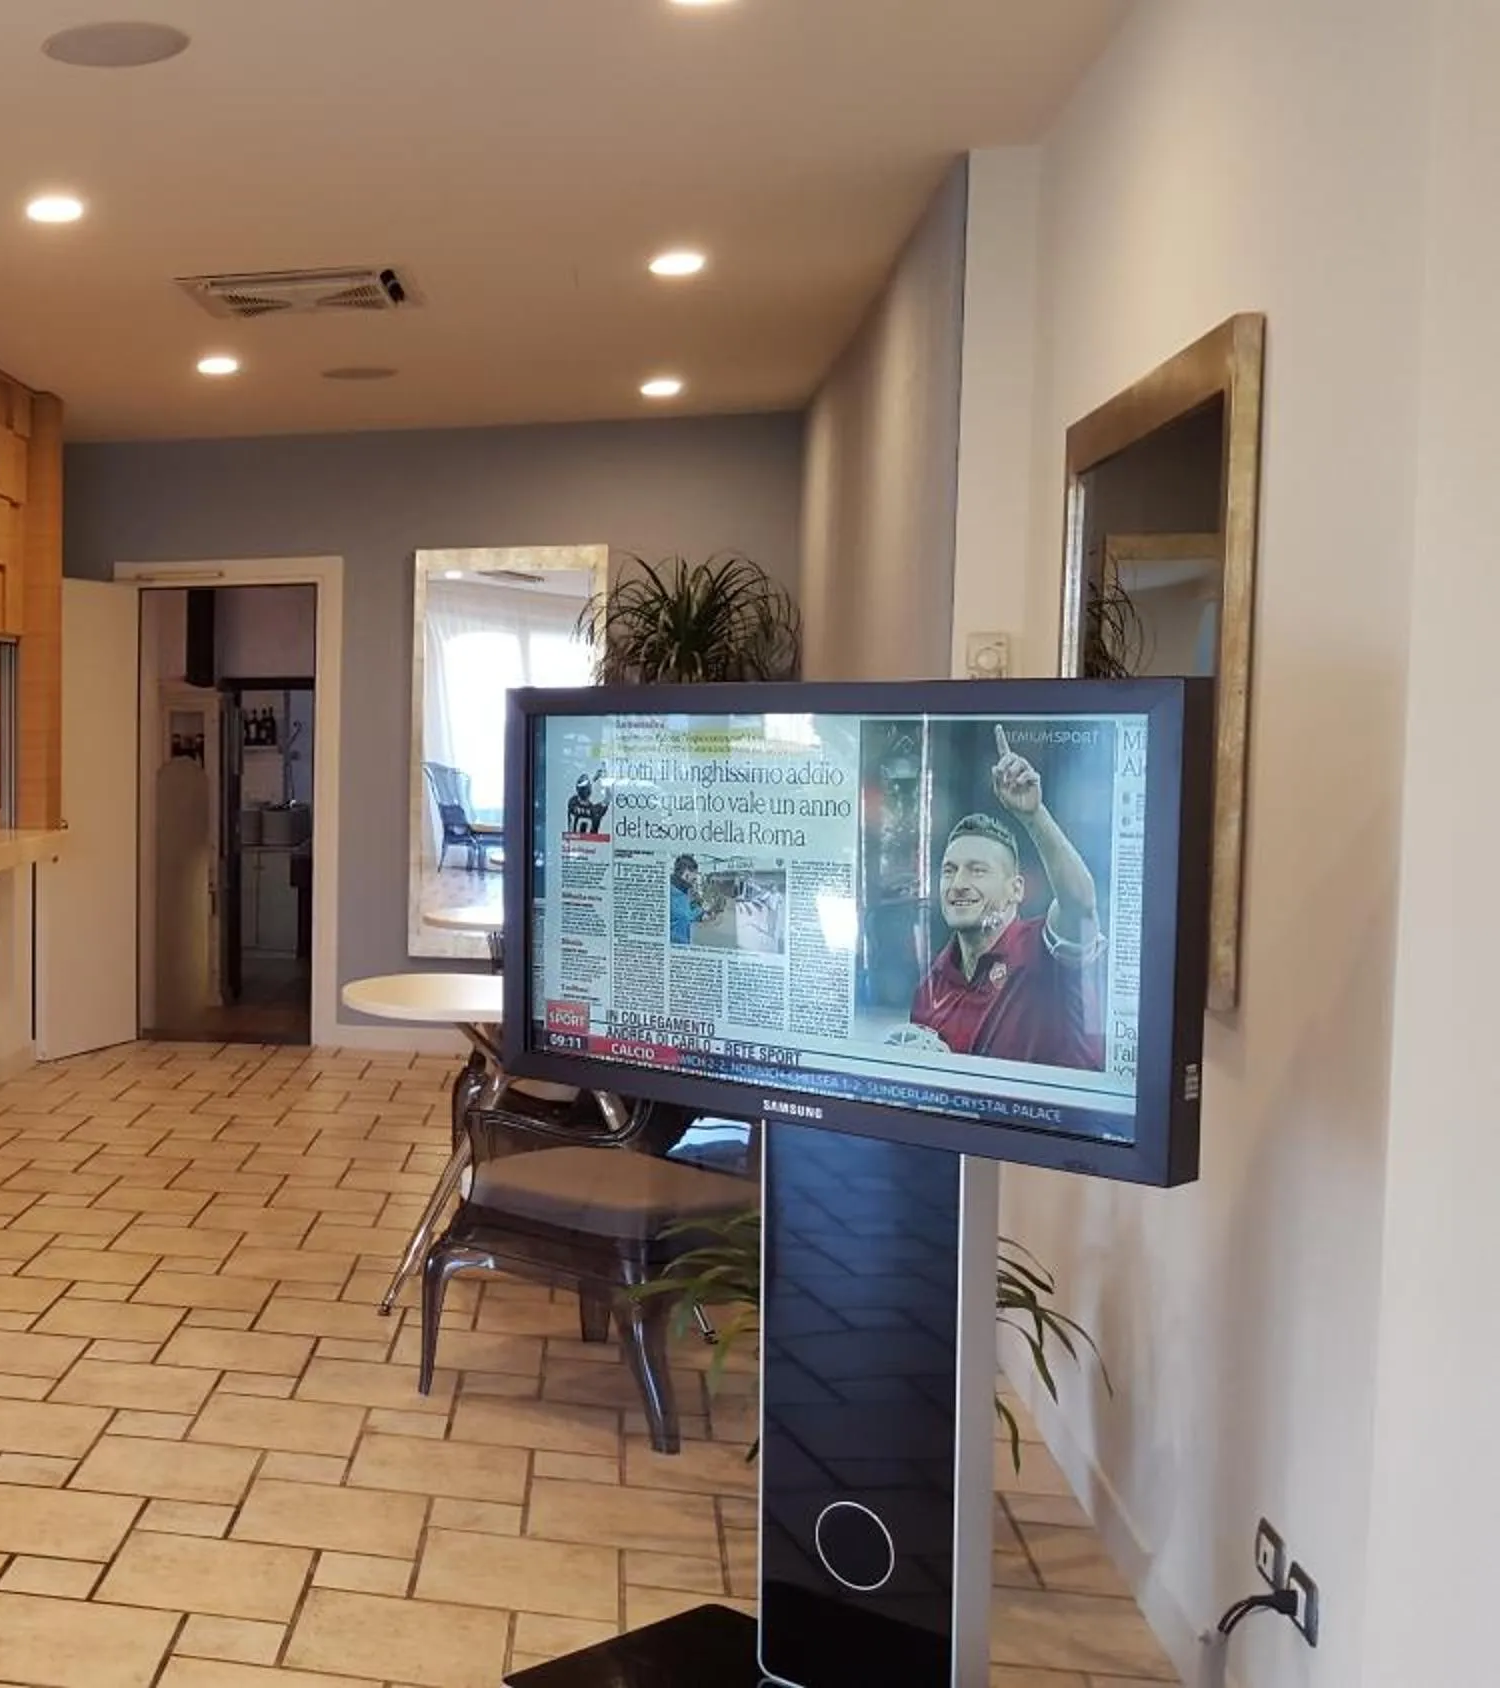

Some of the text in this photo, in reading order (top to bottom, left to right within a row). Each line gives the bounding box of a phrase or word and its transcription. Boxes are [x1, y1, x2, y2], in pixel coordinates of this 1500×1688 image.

[673, 758, 783, 788] lunghissimo
[786, 760, 844, 786] addio
[661, 792, 725, 817] quanto
[728, 790, 766, 815] vale
[770, 798, 795, 815] un
[800, 799, 851, 818] anno
[615, 815, 806, 847] del tesoro della Roma
[606, 1009, 715, 1037] IN COLLEGAMENTO
[610, 1042, 656, 1060] CALCIO
[725, 1041, 756, 1060] RETE
[759, 1044, 802, 1066] SPORT
[762, 1098, 824, 1120] SAMSUNG
[1012, 1102, 1062, 1124] PALACE
